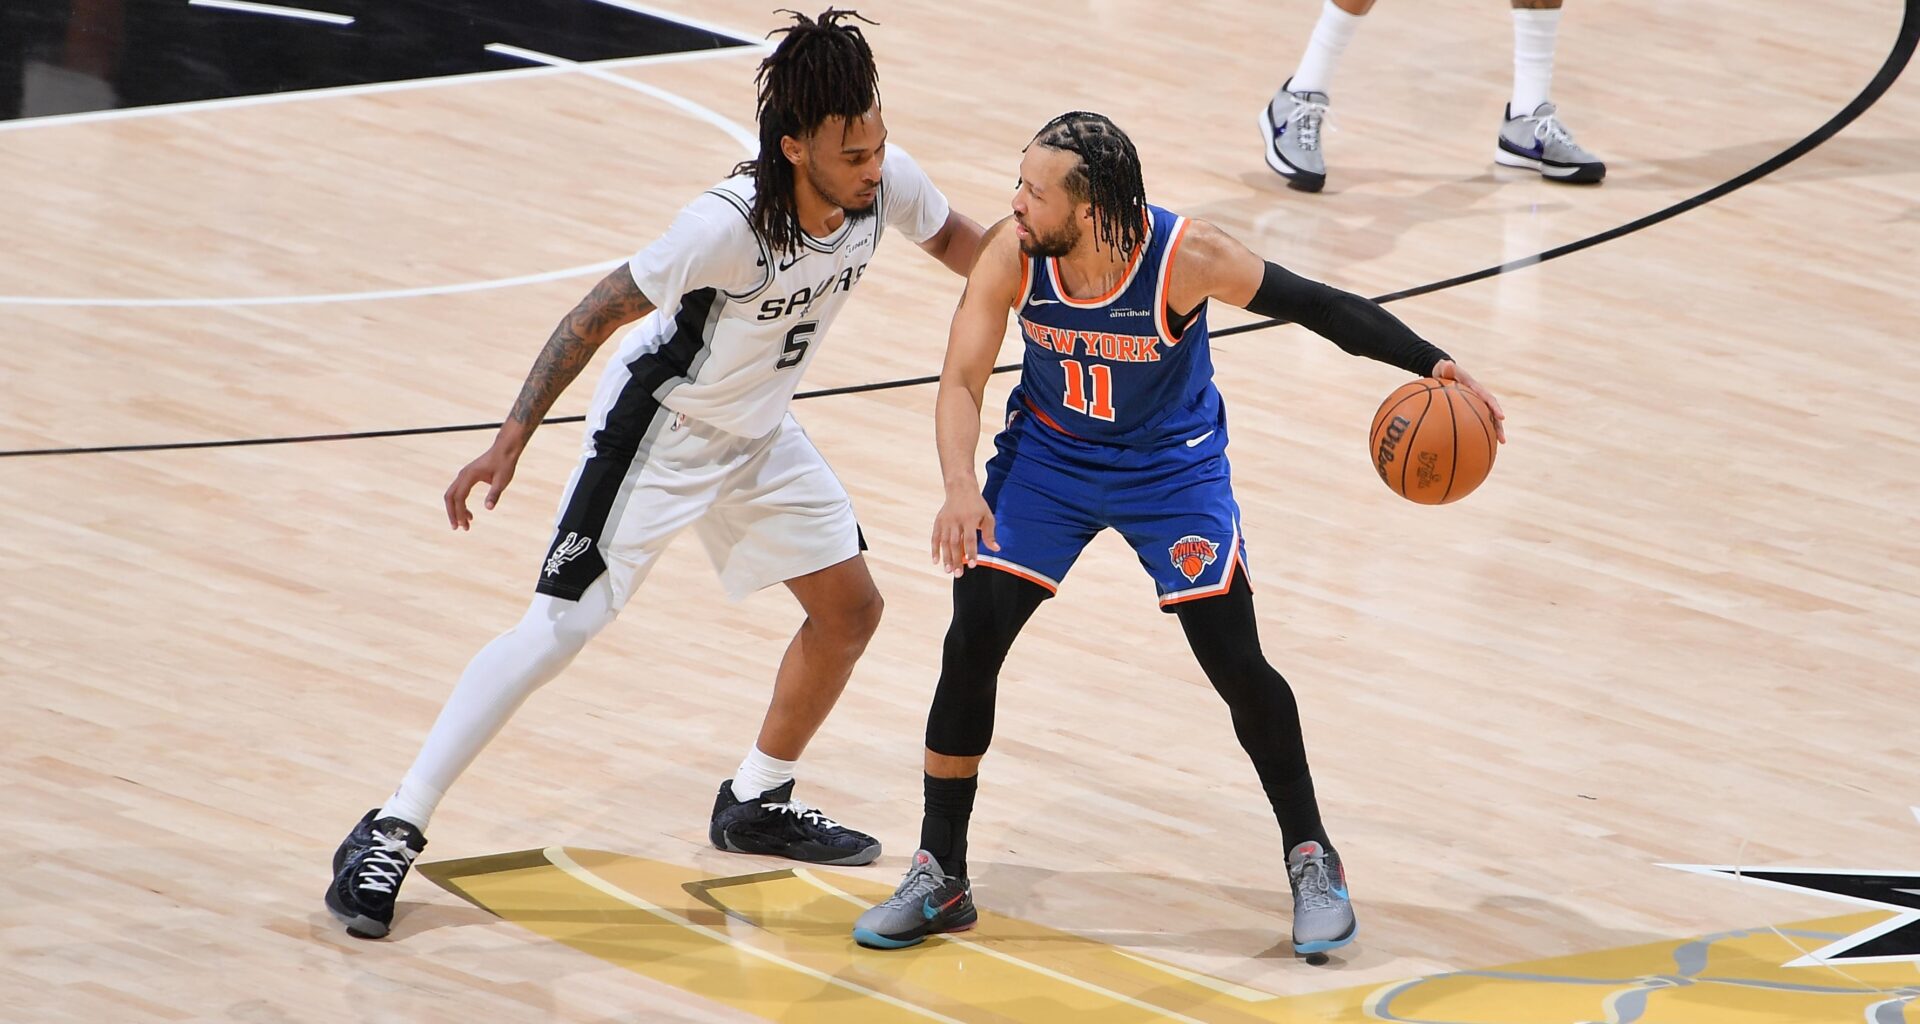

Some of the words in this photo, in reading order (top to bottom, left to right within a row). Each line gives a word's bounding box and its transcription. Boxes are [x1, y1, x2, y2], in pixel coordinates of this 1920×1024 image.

[774, 320, 819, 371] 5
[1021, 317, 1077, 356] NEW
[1080, 331, 1161, 362] YORK
[1060, 359, 1115, 422] 11
[1173, 540, 1215, 562] KNICKS
